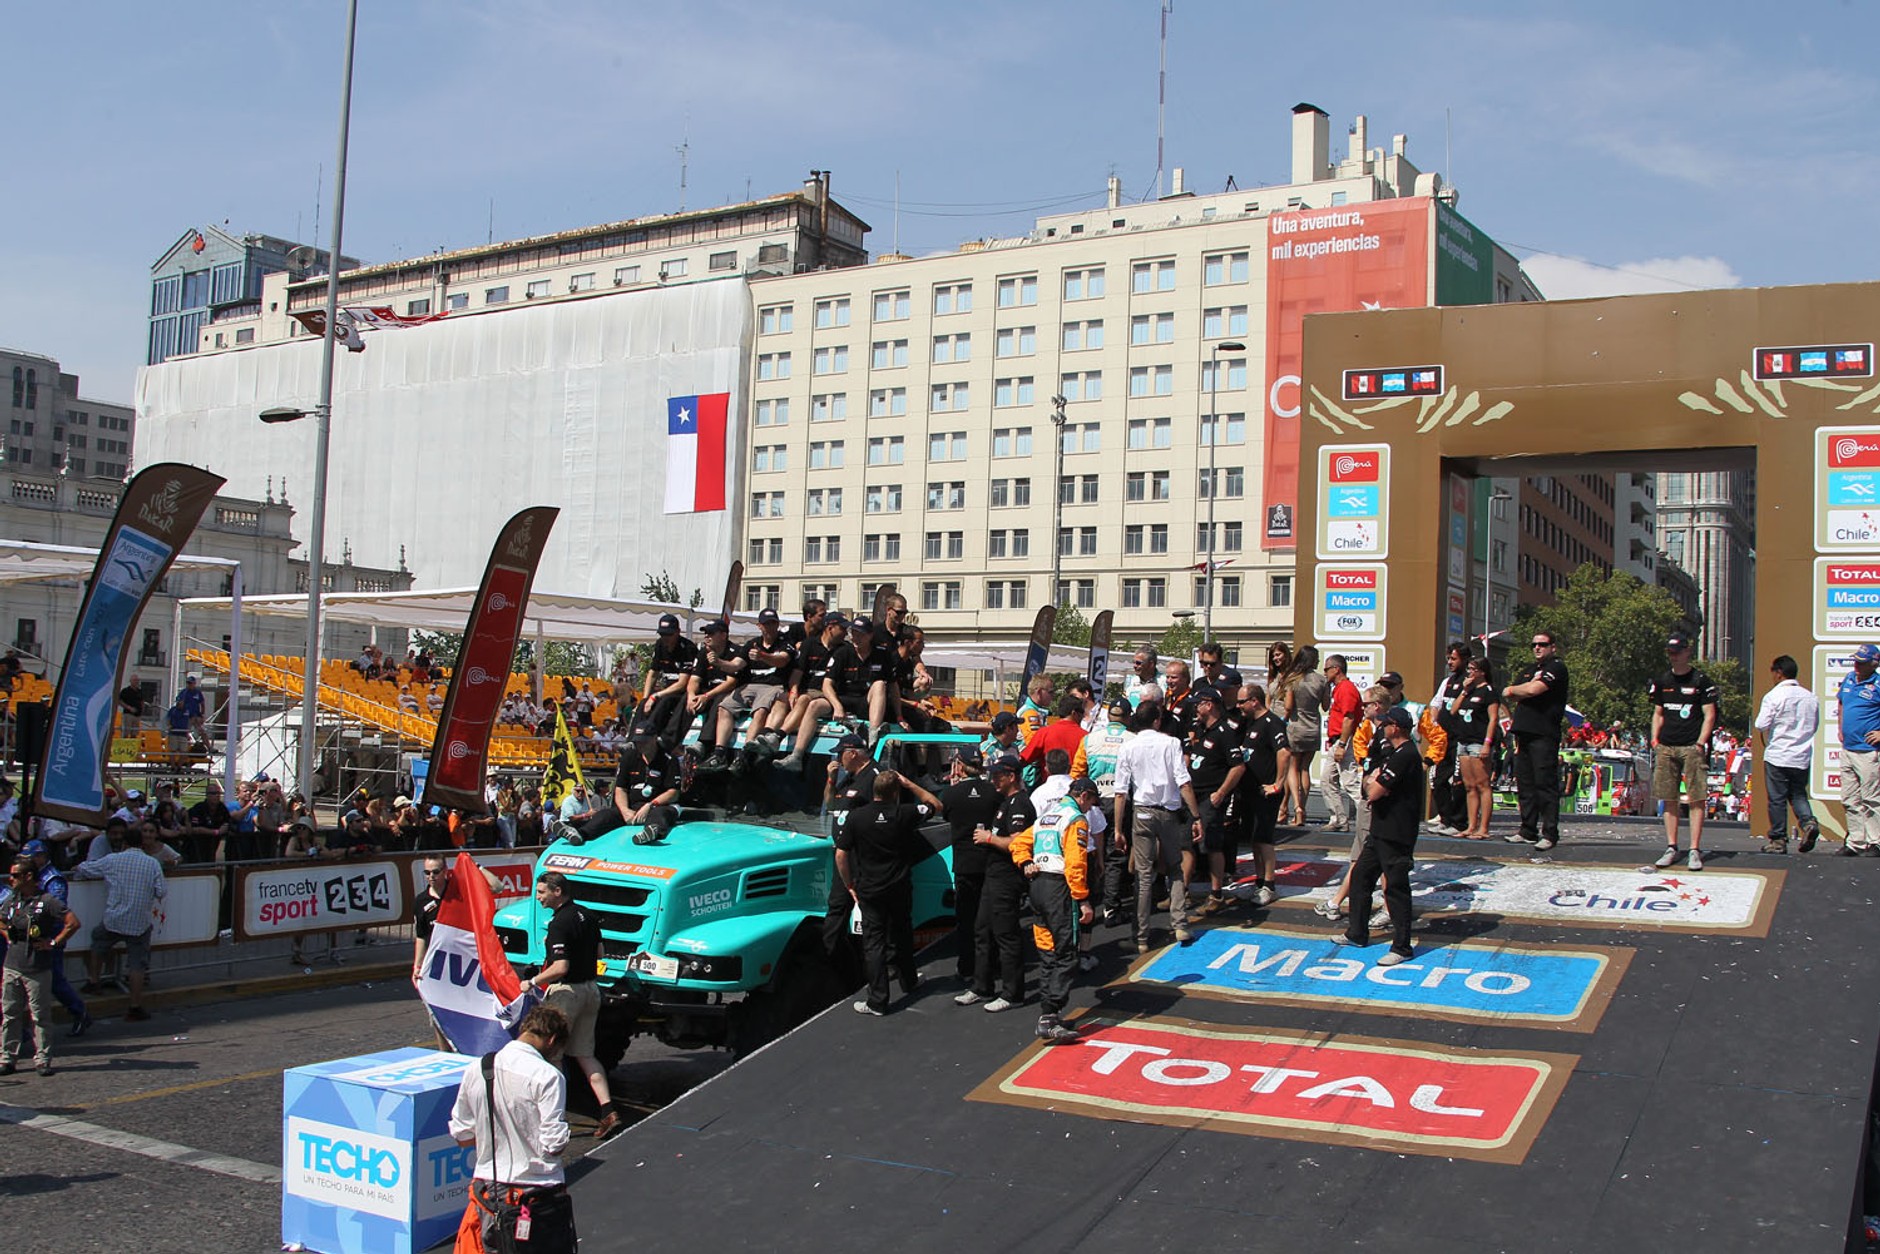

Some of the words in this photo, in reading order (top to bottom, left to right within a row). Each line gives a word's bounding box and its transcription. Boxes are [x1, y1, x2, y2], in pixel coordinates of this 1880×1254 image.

[1272, 216, 1297, 235] Una
[1300, 210, 1364, 232] aventura,
[1272, 241, 1291, 260] mil
[1294, 233, 1380, 260] experiencias
[1334, 538, 1363, 548] Chile
[1836, 528, 1870, 540] Chile
[1329, 574, 1373, 584] TOTAL
[1831, 568, 1880, 580] TOTAL
[1331, 595, 1370, 607] Macro
[1833, 592, 1879, 603] Macro
[1829, 621, 1853, 629] sport
[52, 695, 79, 775] Argentina
[546, 855, 590, 868] FERM
[596, 861, 631, 871] POWER
[633, 865, 666, 876] TOOLS
[259, 879, 318, 899] francetv
[689, 889, 731, 909] IVECO
[259, 895, 318, 925] sport
[691, 901, 732, 917] SCHOUTEN
[1548, 892, 1679, 912] Chile
[1206, 942, 1531, 996] Macro
[1084, 1039, 1484, 1117] TOTAL
[298, 1132, 400, 1188] TECHO
[428, 1145, 477, 1188] TEC
[303, 1174, 315, 1185] UN
[317, 1178, 342, 1192] TECHO
[344, 1183, 365, 1197] PARA
[367, 1189, 376, 1200] MI
[377, 1191, 395, 1204] PAÍS
[433, 1191, 446, 1203] UN
